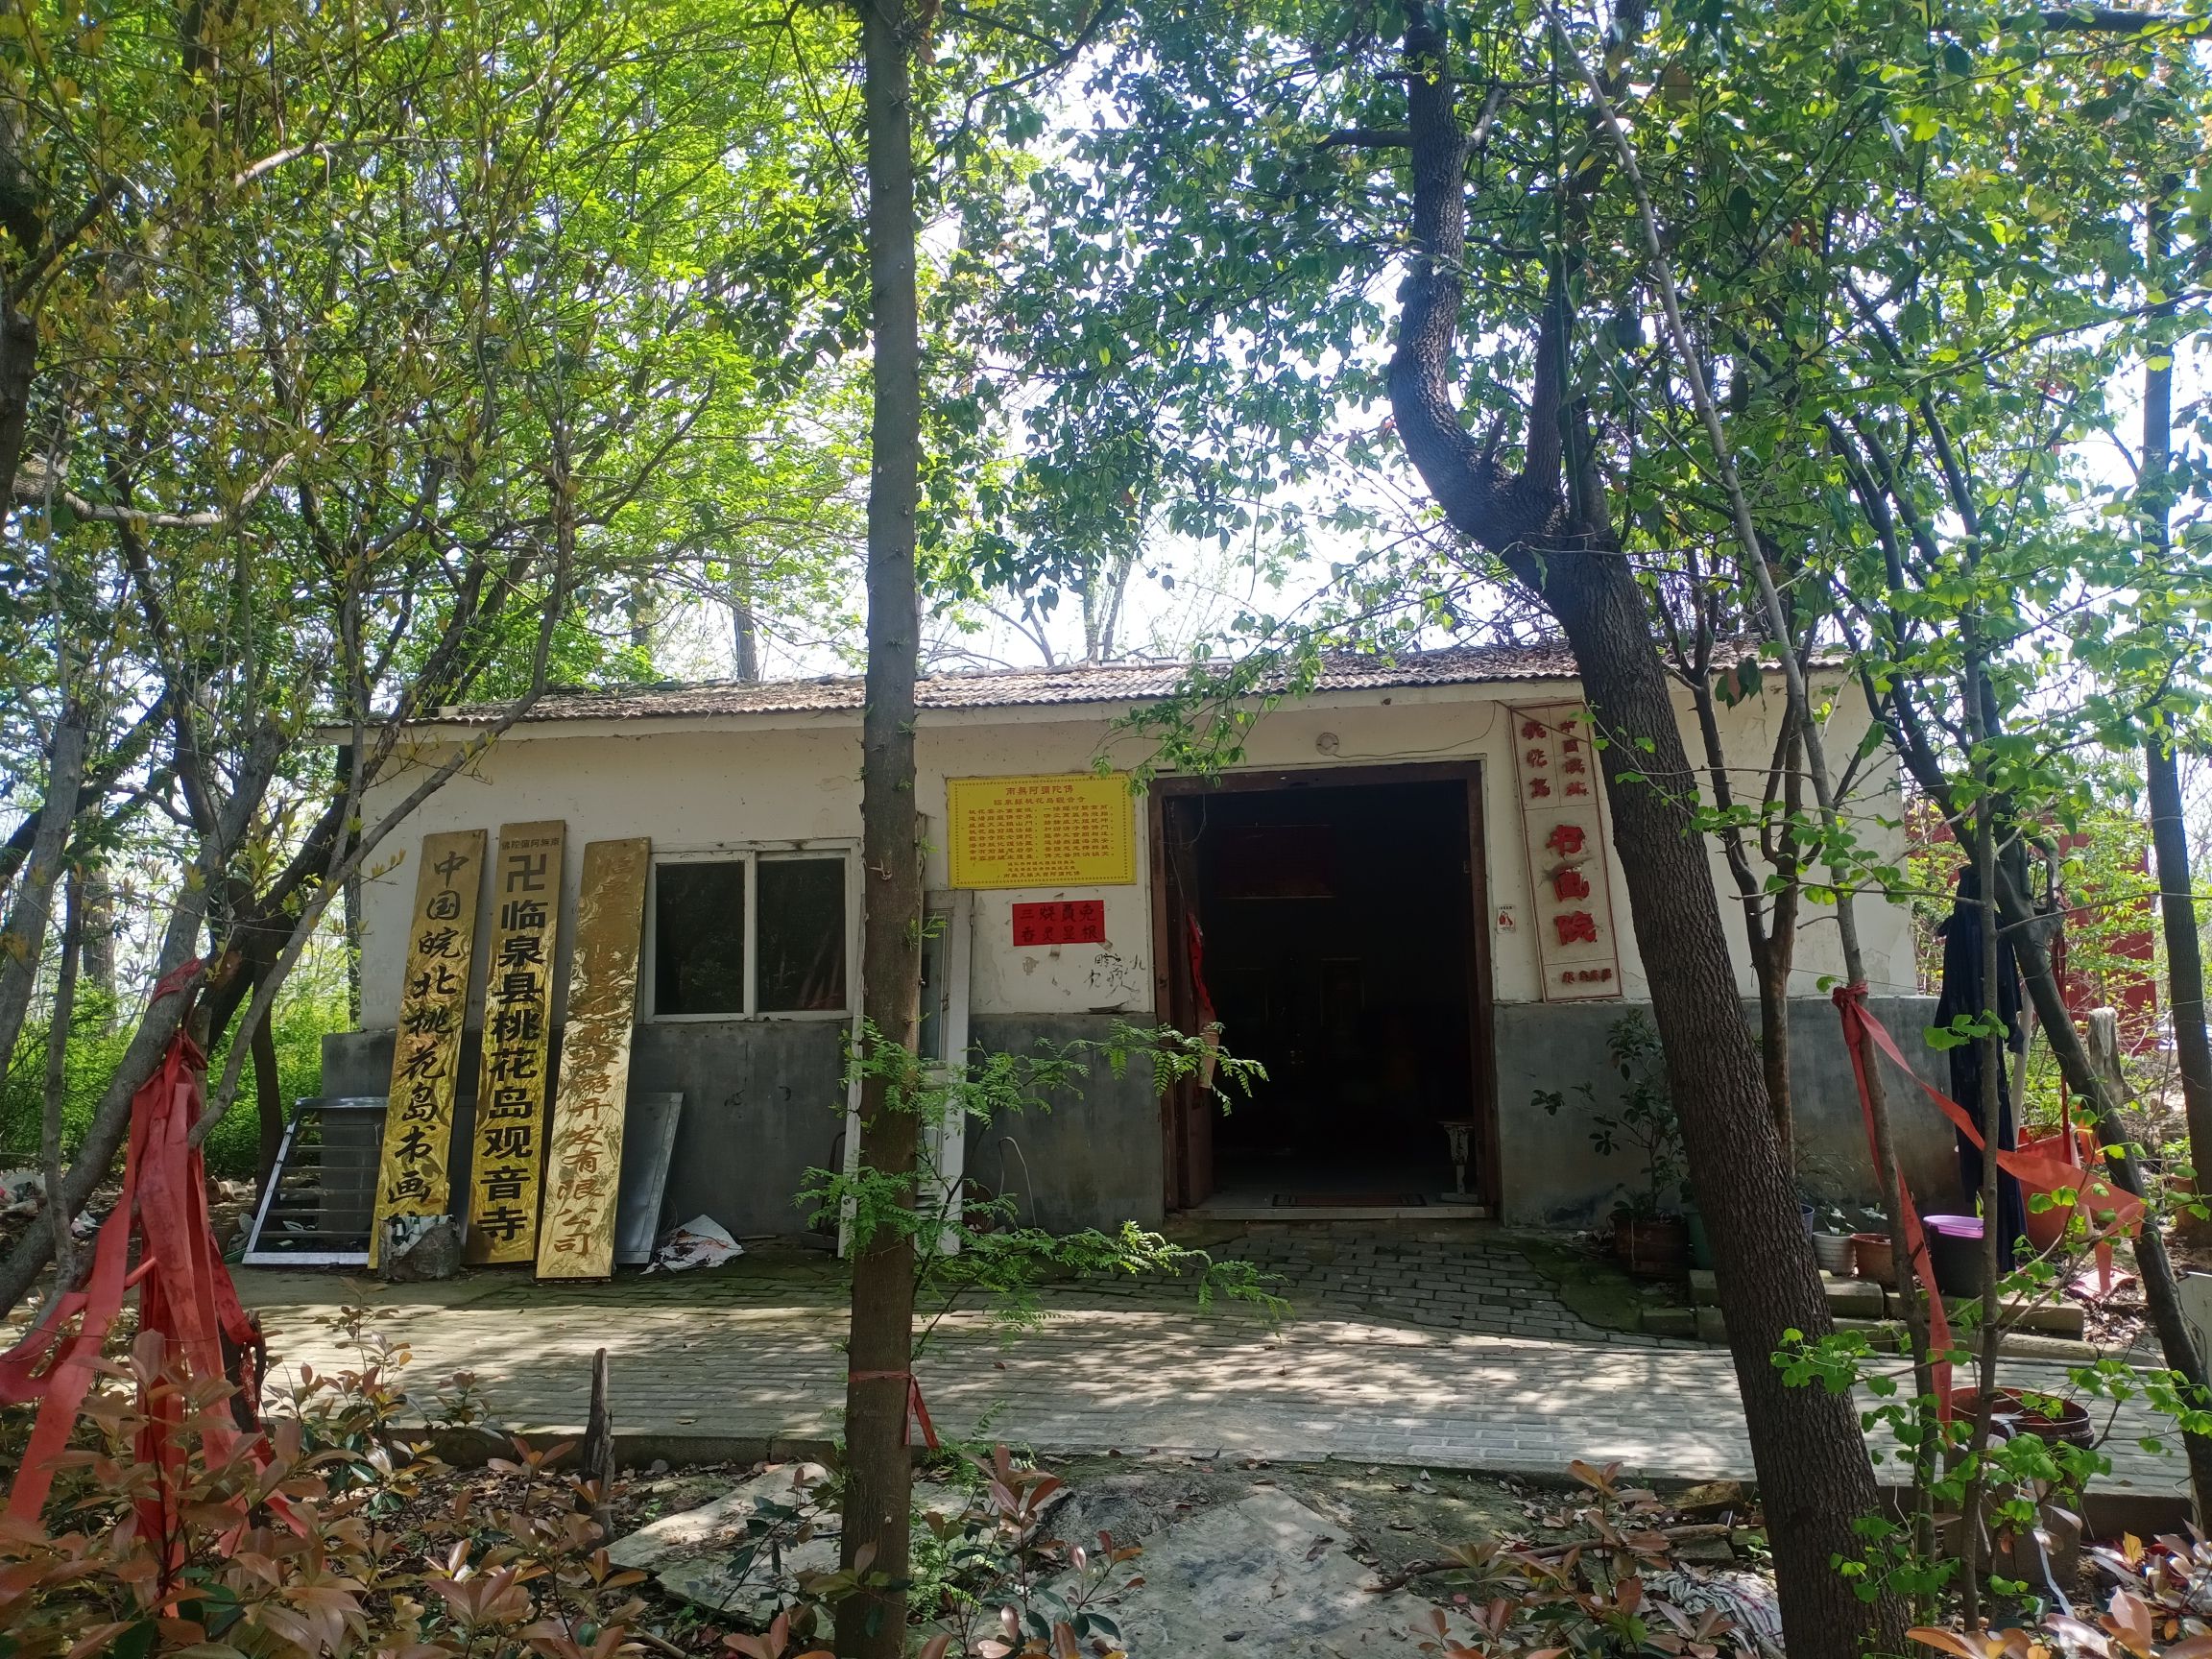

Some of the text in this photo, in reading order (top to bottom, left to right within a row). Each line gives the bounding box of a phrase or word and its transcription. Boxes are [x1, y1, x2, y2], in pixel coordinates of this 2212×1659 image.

[388, 851, 469, 1217] 中国皖北桃花岛书画
